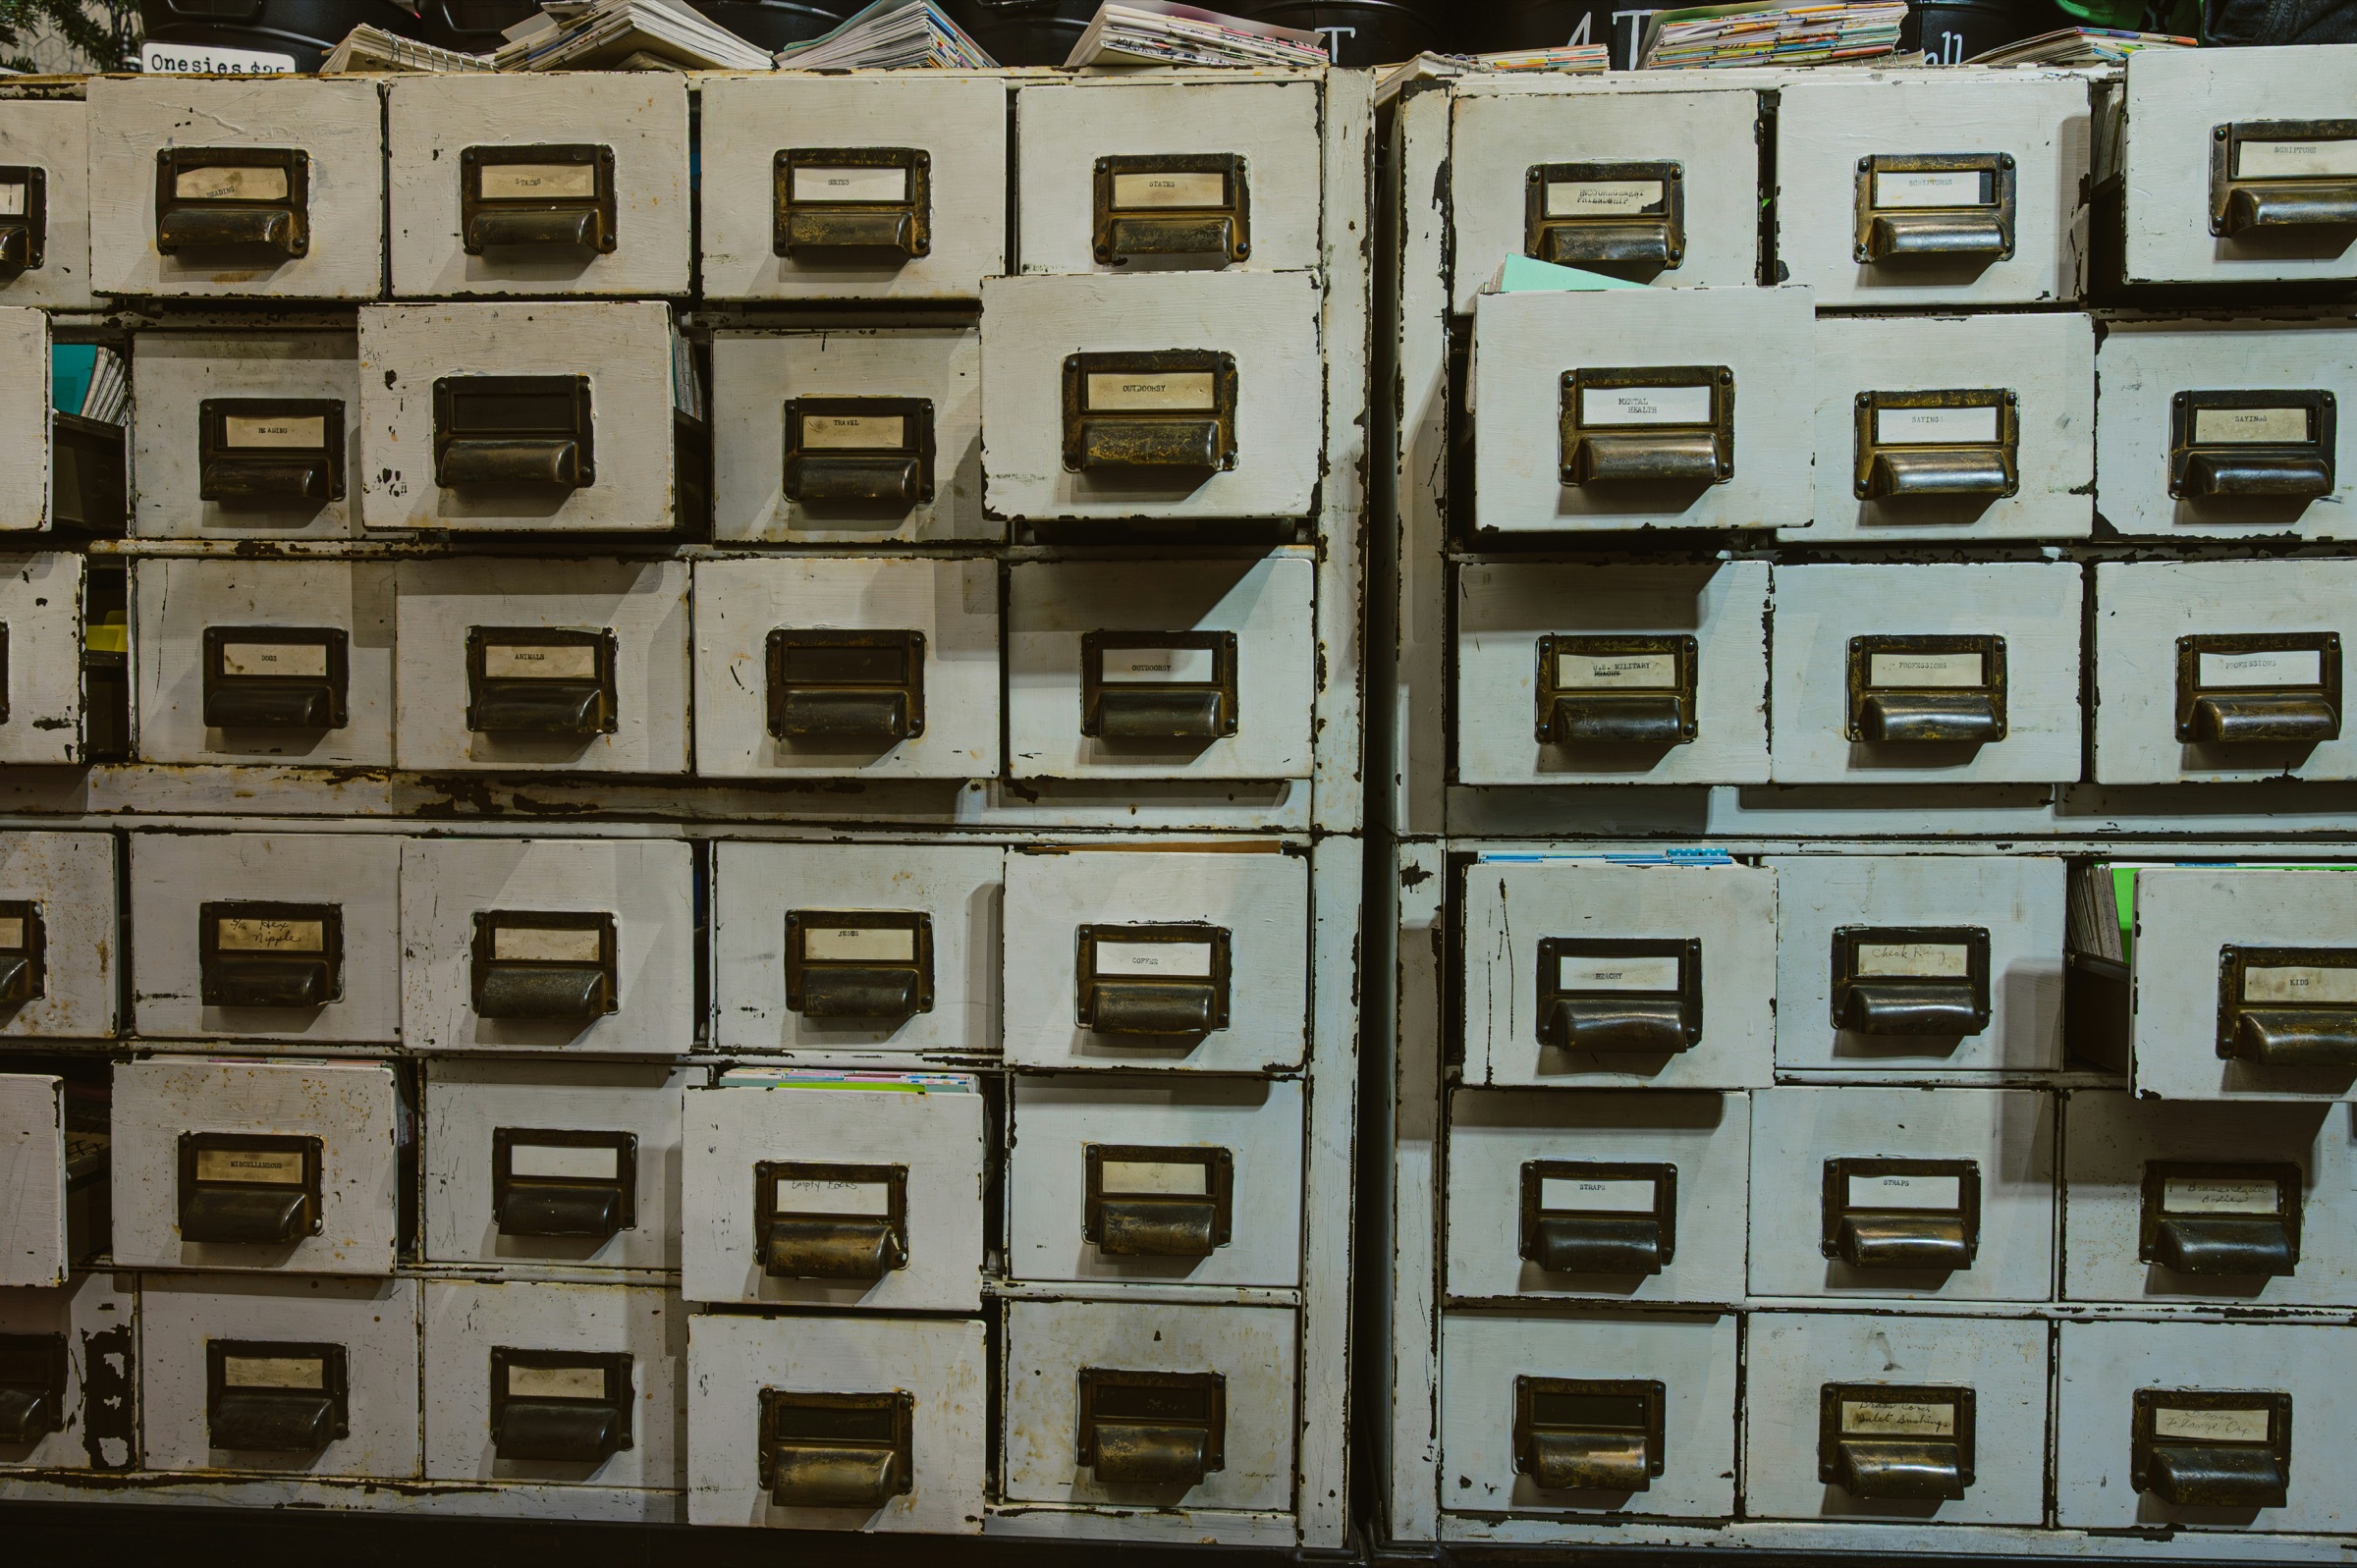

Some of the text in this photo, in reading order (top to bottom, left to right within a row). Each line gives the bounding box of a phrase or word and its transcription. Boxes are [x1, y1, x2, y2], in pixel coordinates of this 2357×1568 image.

[151, 54, 242, 75] Onesies
[1579, 189, 1645, 197] ENCOURAGEMENT
[2225, 660, 2276, 670] PROFESSIONS
[1872, 945, 1908, 959] Check
